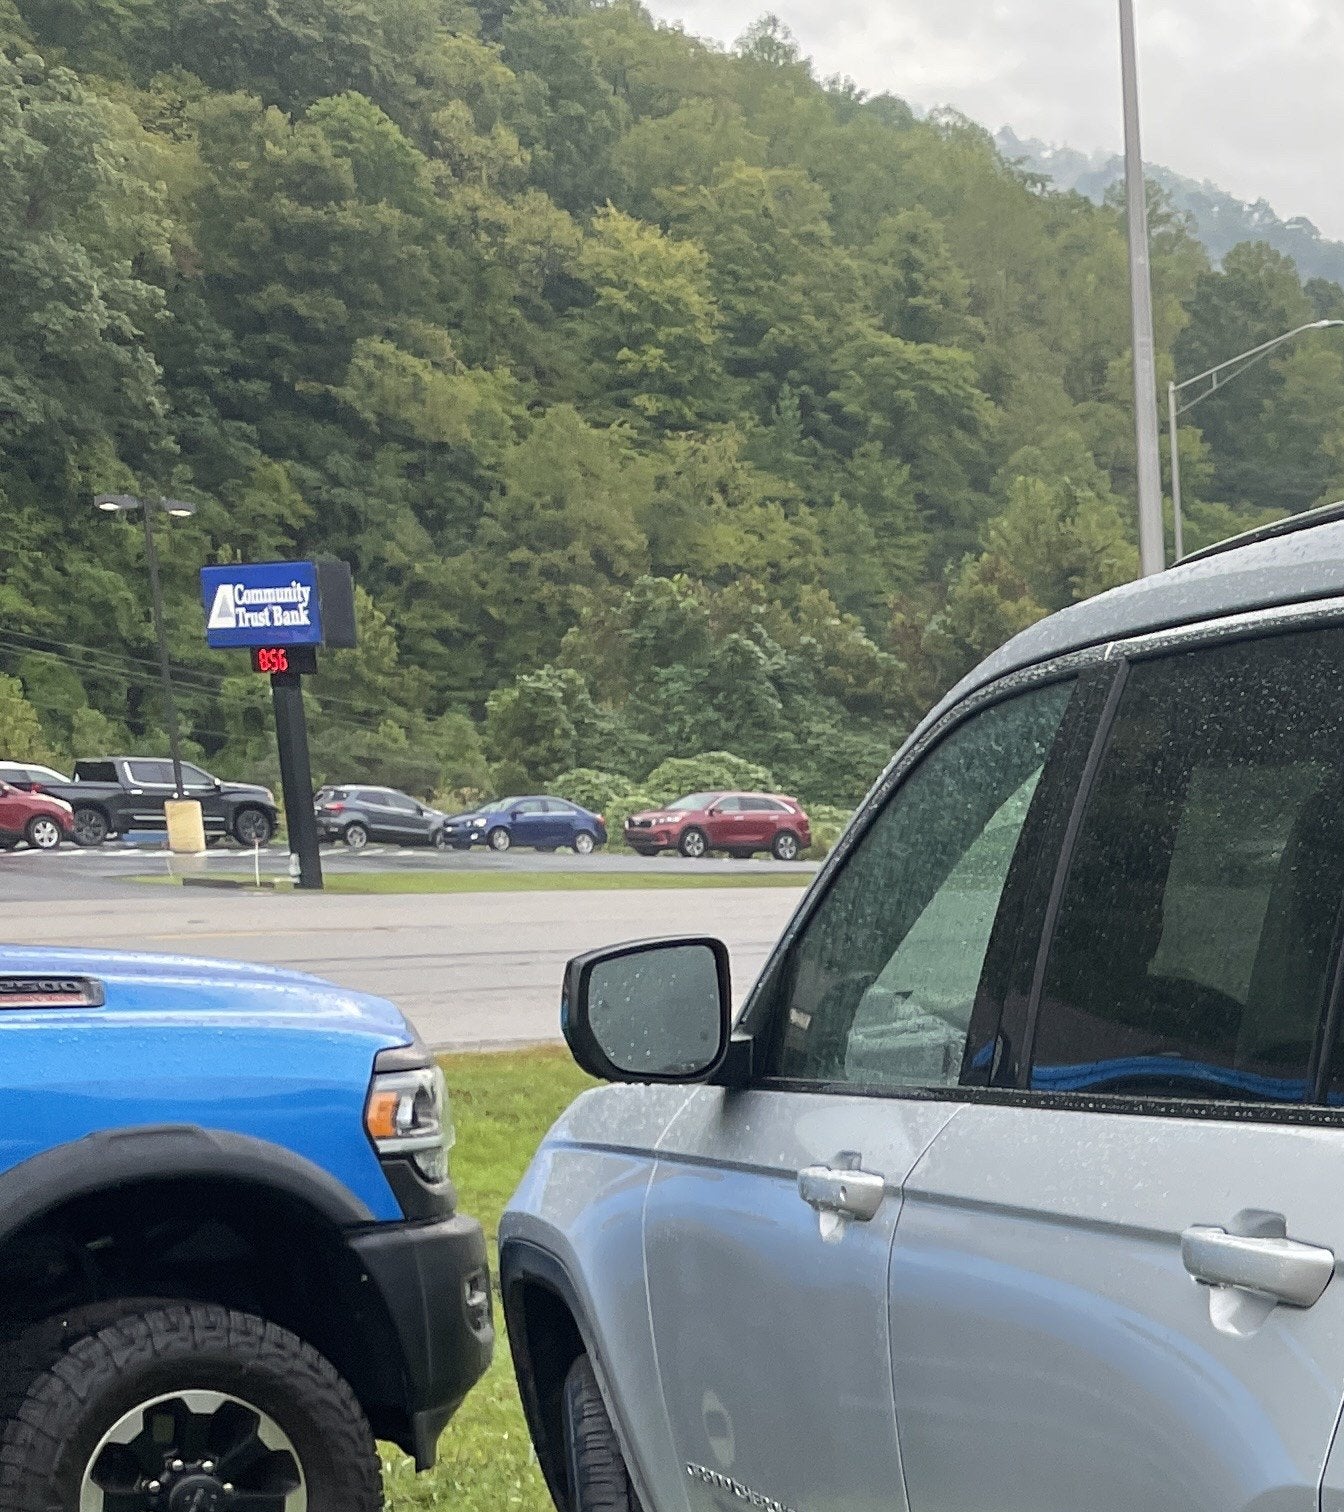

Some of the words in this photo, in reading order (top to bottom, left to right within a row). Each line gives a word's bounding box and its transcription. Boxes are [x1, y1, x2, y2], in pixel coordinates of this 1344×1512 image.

[234, 580, 311, 607] Community
[235, 606, 271, 628] Trust
[273, 604, 311, 626] Bank
